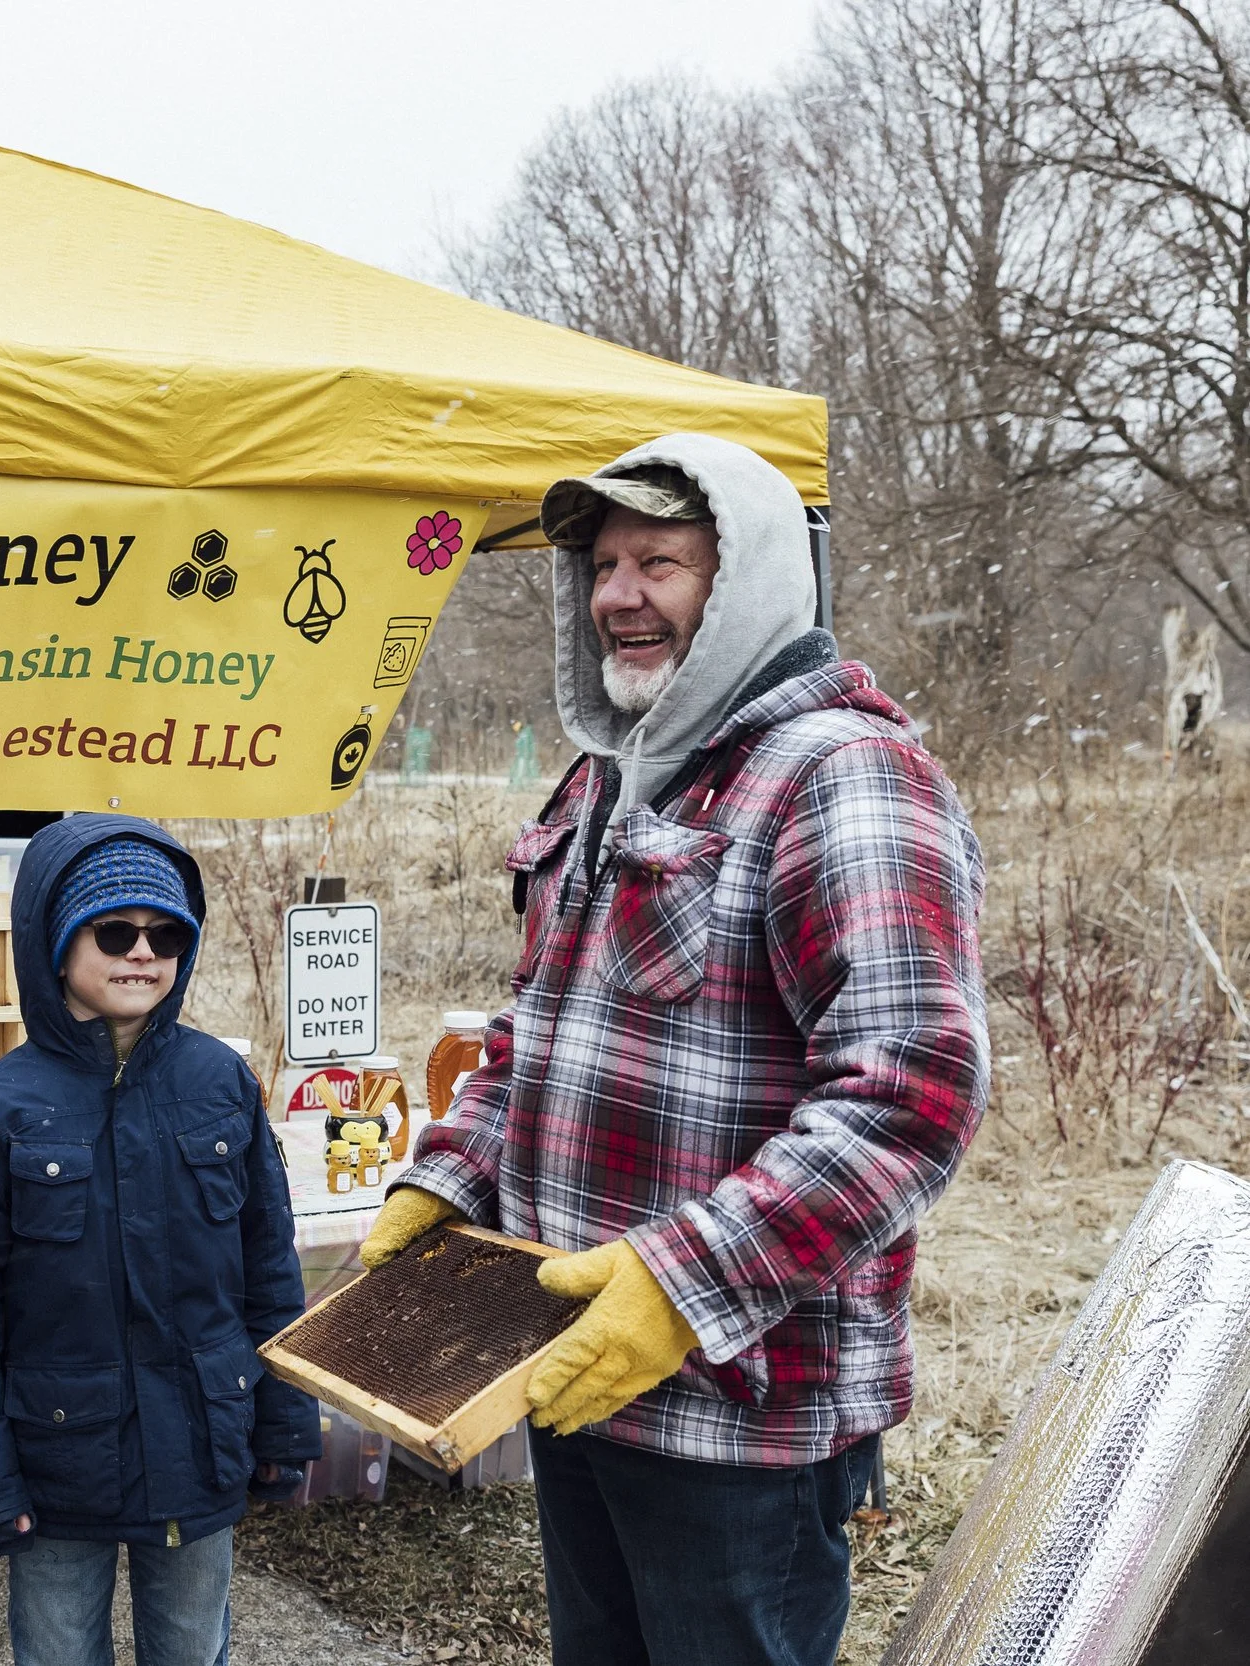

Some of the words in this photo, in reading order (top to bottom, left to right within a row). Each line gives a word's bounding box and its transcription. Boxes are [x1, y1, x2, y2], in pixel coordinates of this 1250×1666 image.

[105, 634, 276, 701] Honey
[187, 723, 282, 771] LLC
[293, 928, 373, 947] SERVICE
[307, 952, 360, 970] ROAD
[298, 998, 325, 1015] DO
[331, 995, 369, 1012] NOT
[302, 1019, 363, 1038] ENTER
